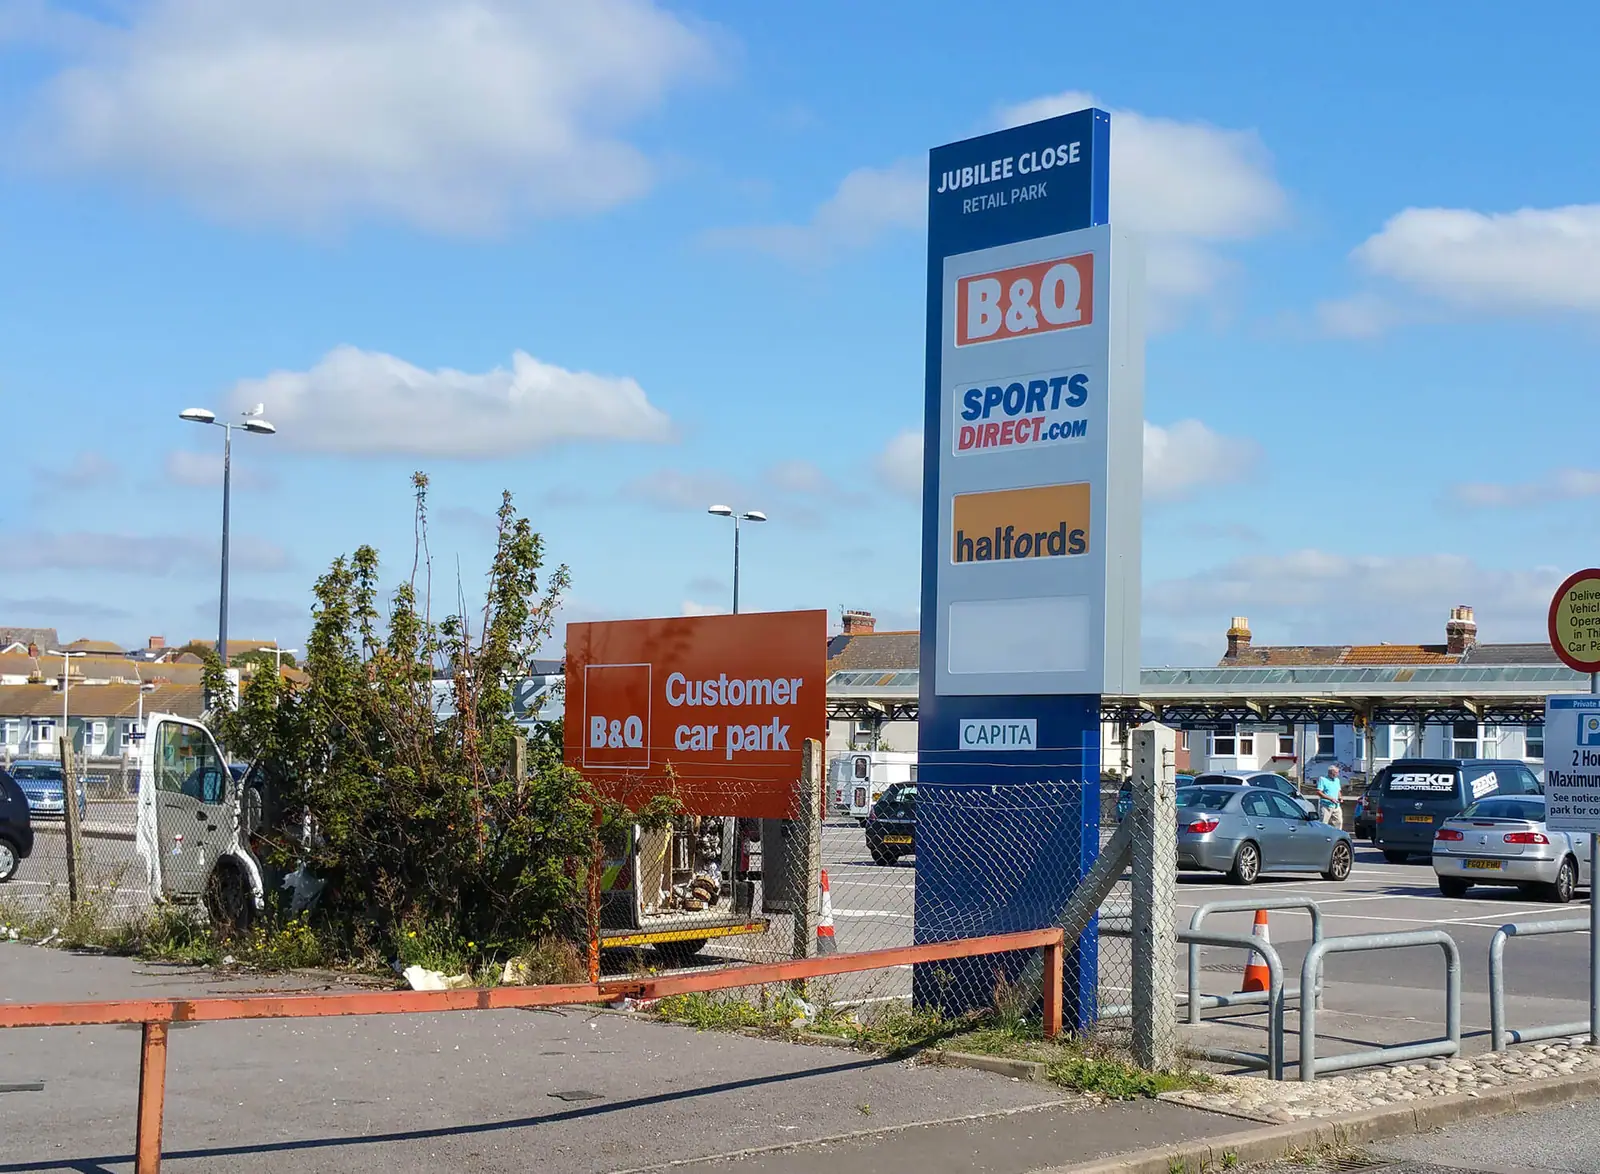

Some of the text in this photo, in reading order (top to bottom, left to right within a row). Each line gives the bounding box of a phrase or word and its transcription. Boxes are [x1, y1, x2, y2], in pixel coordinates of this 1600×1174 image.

[937, 142, 1081, 193] JUBILEE CLOSE
[963, 182, 1048, 214] RETAIL PARK
[967, 263, 1081, 340] B&Q
[960, 373, 1089, 421] SPORTS
[958, 416, 1087, 451] DIRECT.COM
[957, 521, 1086, 563] halfords
[1568, 641, 1586, 652] Car
[1574, 629, 1582, 639] in
[665, 672, 802, 707] Customer
[1573, 700, 1597, 708] Private
[590, 716, 643, 748] B&Q
[674, 716, 790, 760] car park
[964, 724, 1032, 745] CAPITA
[1572, 750, 1579, 766] 2
[1390, 773, 1454, 786] ZEEKO
[1550, 805, 1570, 816] park
[1573, 805, 1586, 814] for
[1553, 793, 1600, 802] See notice
